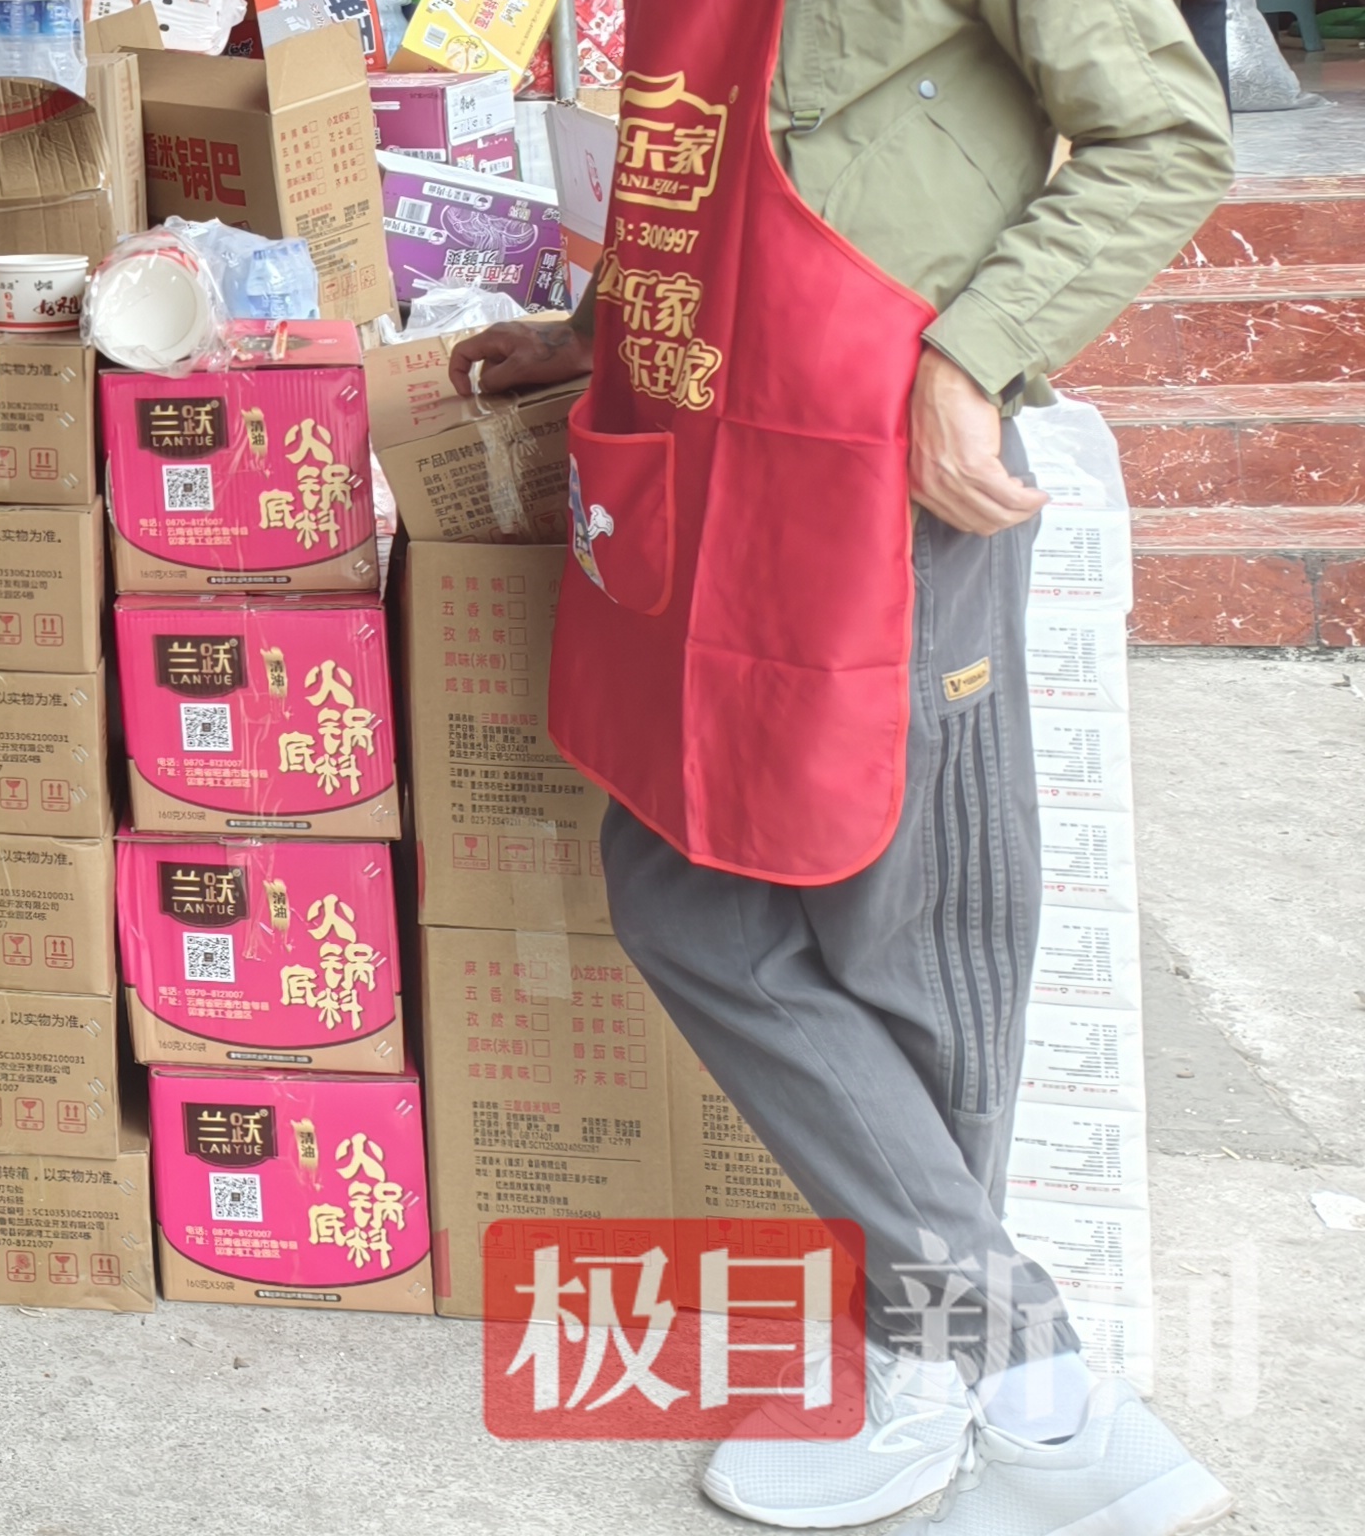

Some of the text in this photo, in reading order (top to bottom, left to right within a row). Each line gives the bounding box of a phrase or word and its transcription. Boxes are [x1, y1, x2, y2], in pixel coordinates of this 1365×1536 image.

[624, 334, 718, 410] 乐到家
[150, 402, 214, 437] 兰跃
[152, 434, 215, 447] LANYUE
[249, 419, 267, 448] 清油
[168, 641, 234, 675] 兰跃
[170, 673, 233, 686] LANYUE
[269, 658, 286, 689] 清油
[171, 871, 236, 906] 兰跃
[172, 903, 236, 916] LANYUE
[272, 890, 289, 921] 清油
[464, 961, 527, 977] 麻辣味
[571, 965, 624, 983] 小龙虾味
[464, 986, 528, 1004] 五香味
[571, 991, 625, 1009] 芝士味
[466, 1011, 529, 1029] 孜然味
[573, 1042, 626, 1061] 番茄味
[468, 1063, 531, 1080] 咸蛋黄味
[573, 1069, 628, 1087] 芥末味
[197, 1110, 263, 1145] 兰跃
[199, 1143, 263, 1157] LANYUE
[300, 1131, 315, 1160] 清油
